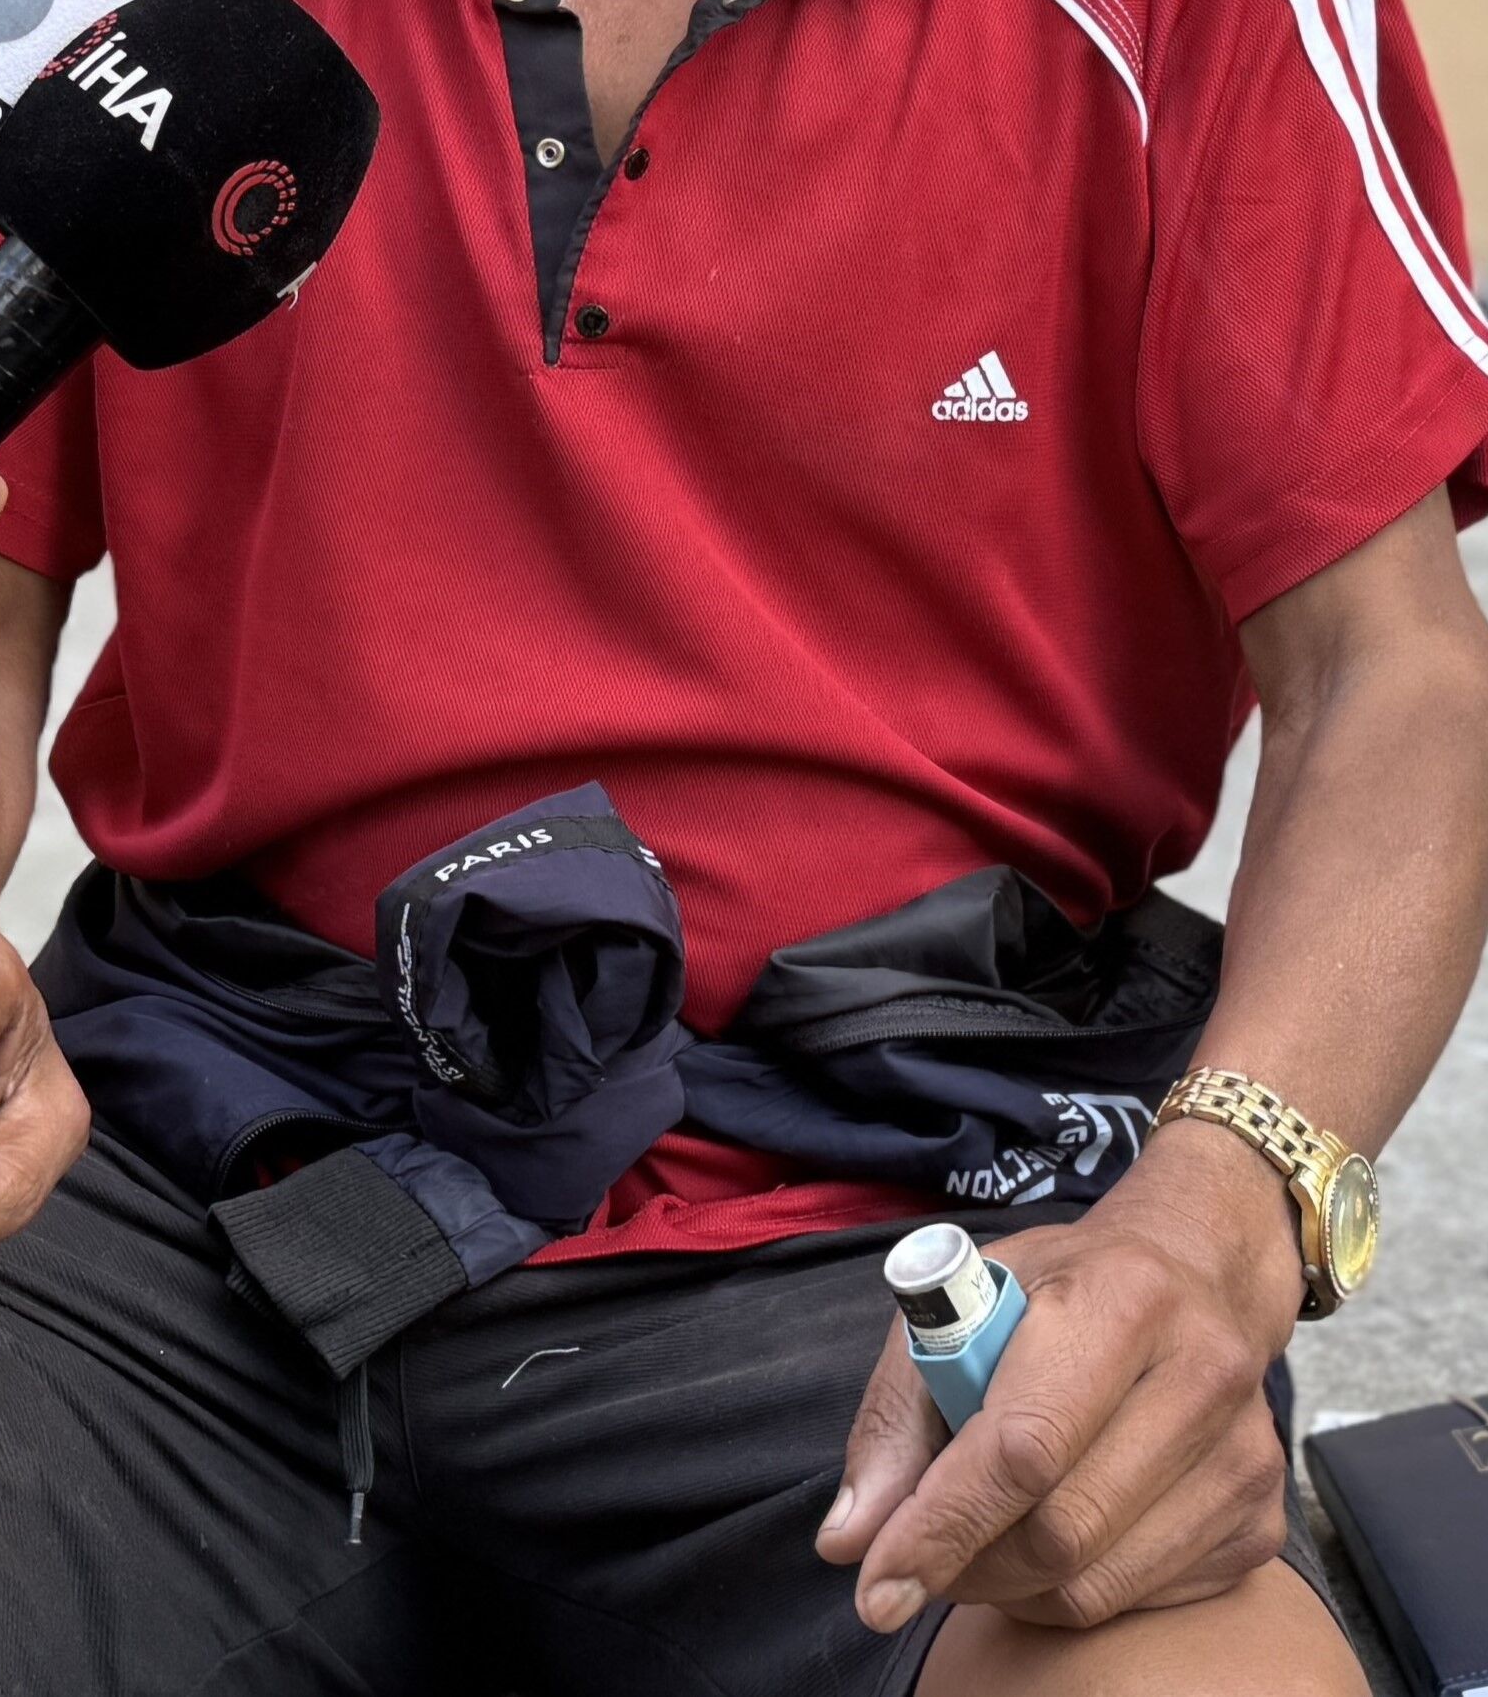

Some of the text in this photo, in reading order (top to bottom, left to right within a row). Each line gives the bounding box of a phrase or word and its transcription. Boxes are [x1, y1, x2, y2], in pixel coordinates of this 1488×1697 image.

[67, 31, 174, 152] İHA
[931, 396, 1029, 422] adidas
[434, 827, 553, 882] PARIS
